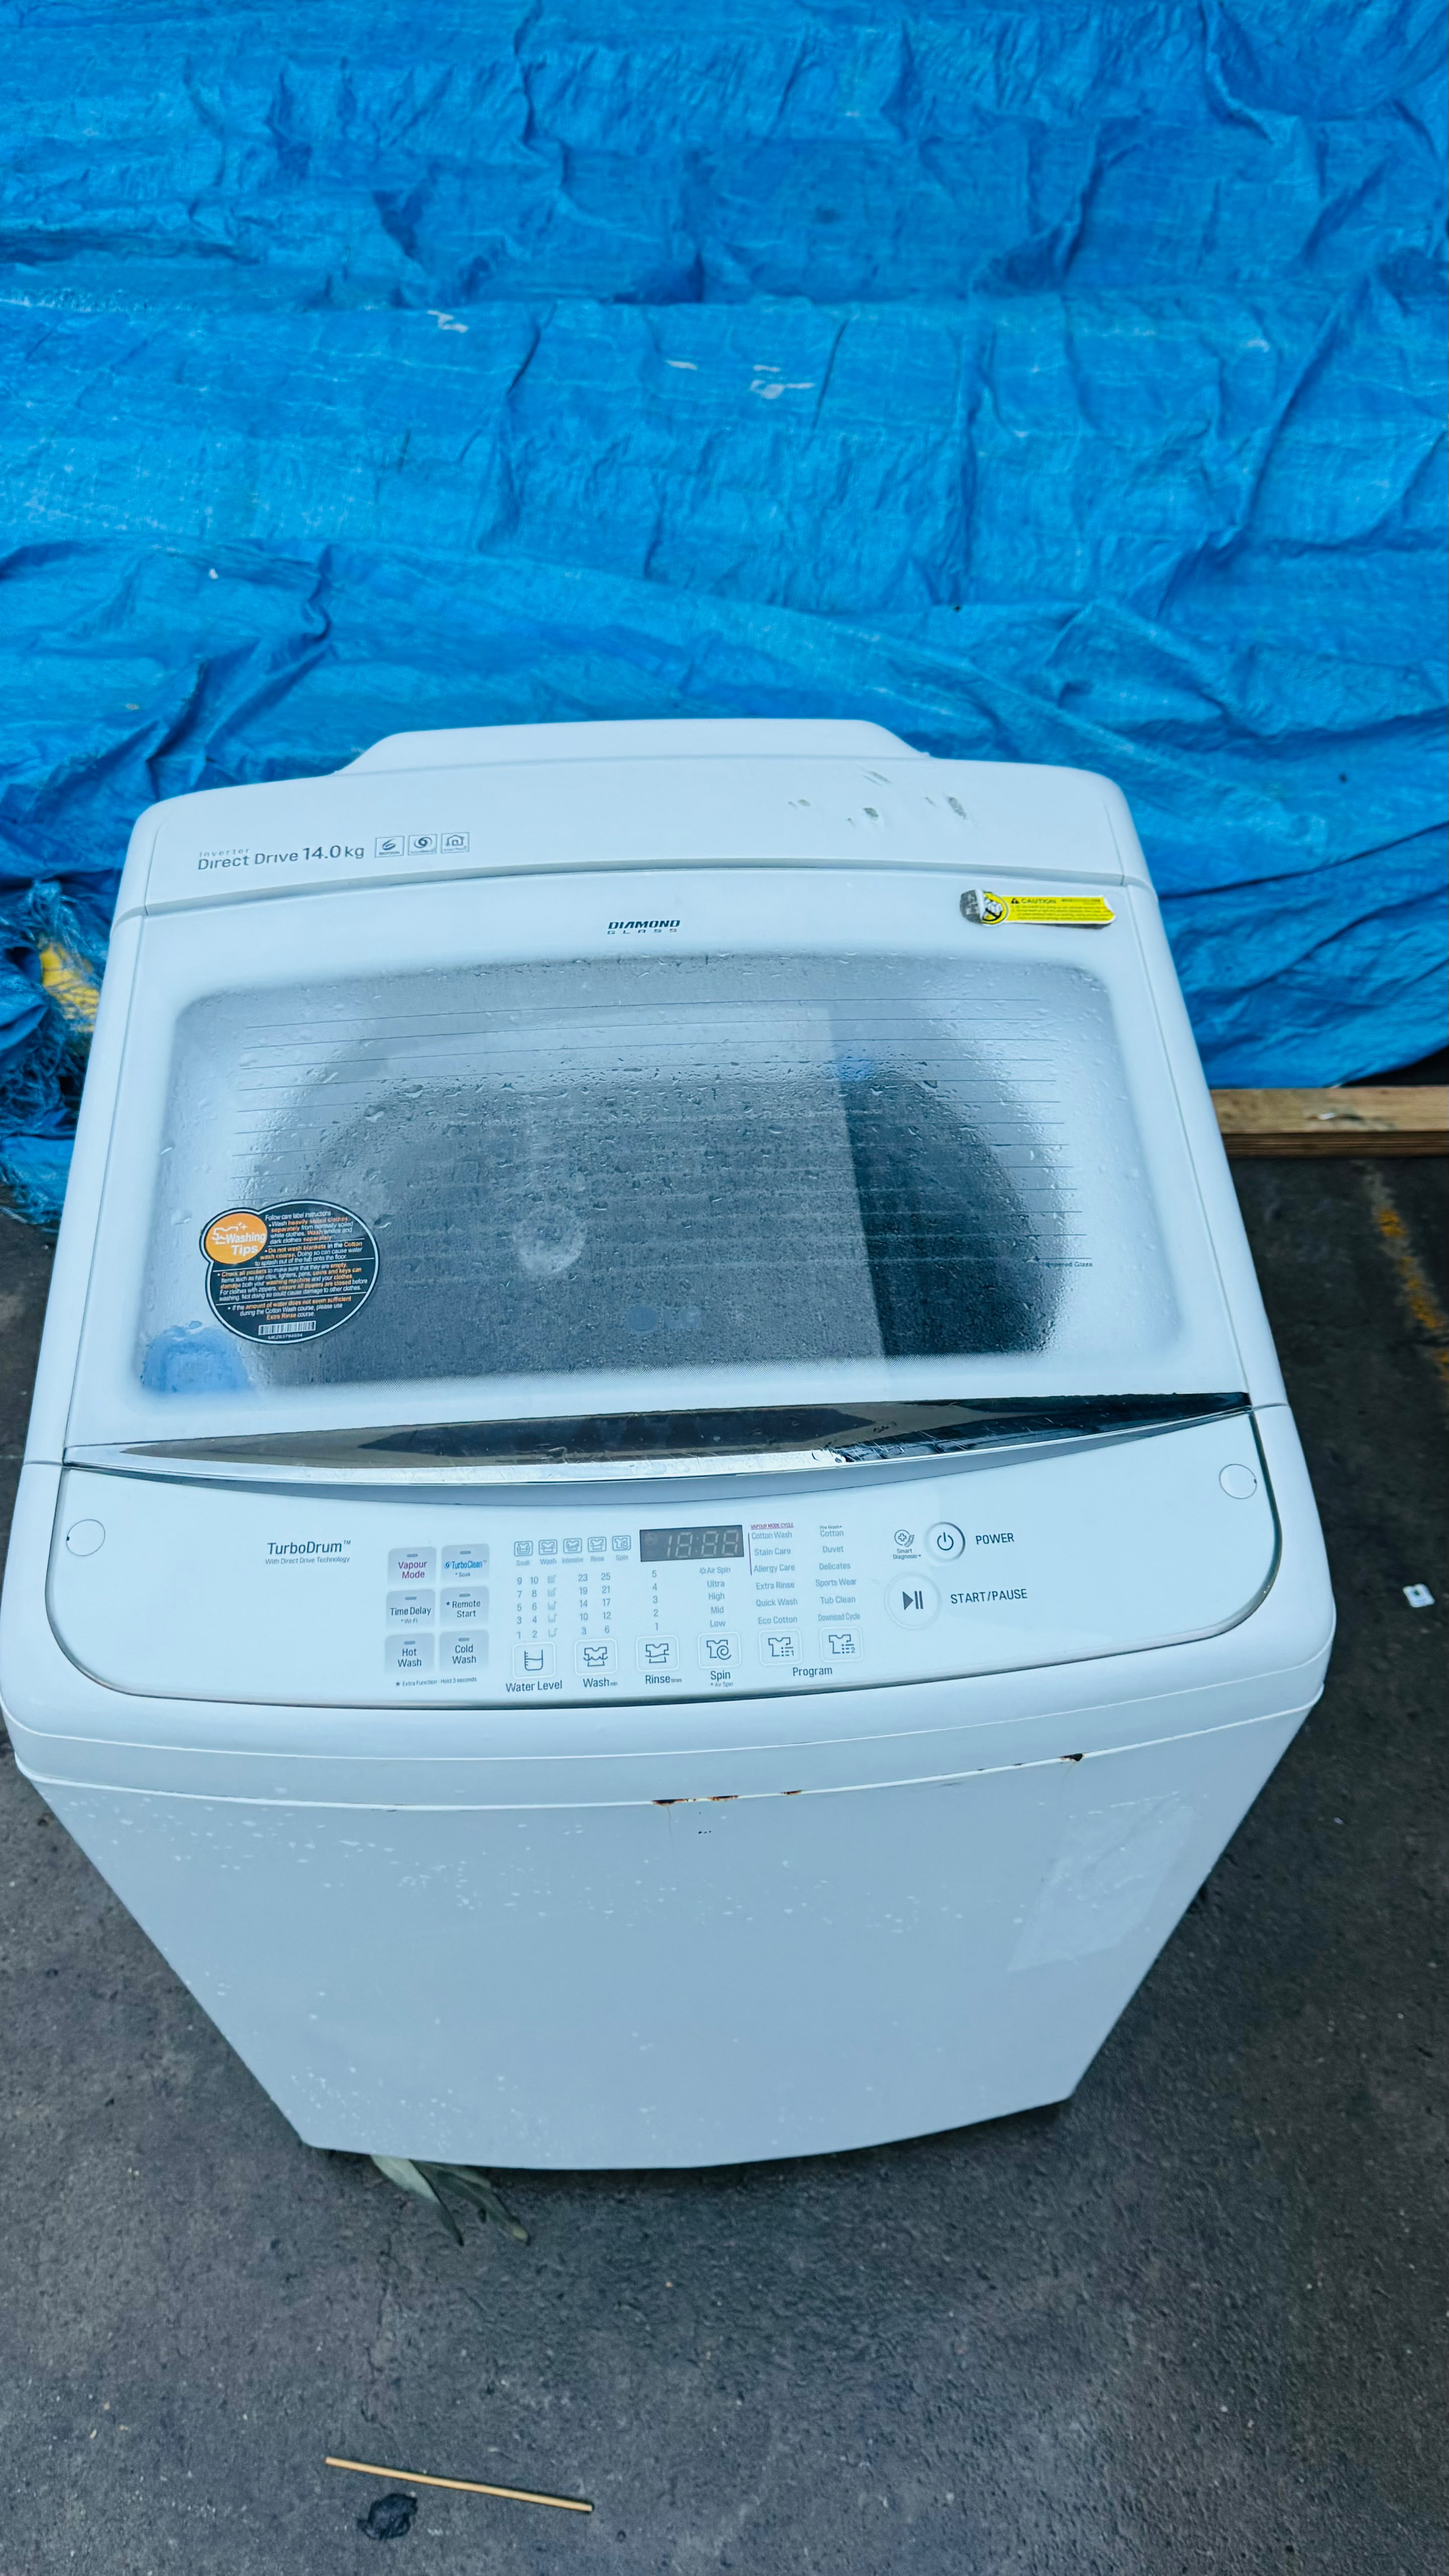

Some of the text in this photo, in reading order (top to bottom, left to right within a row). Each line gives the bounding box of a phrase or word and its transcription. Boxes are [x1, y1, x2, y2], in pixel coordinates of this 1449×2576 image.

[198, 855, 250, 870] Direct
[255, 852, 298, 865] Drive
[608, 920, 680, 929] DIAMOND
[225, 1232, 266, 1244] Washing
[231, 1244, 259, 1257] Tips
[752, 1531, 792, 1540] Cotton Wash
[976, 1533, 1014, 1545] POWER
[398, 1561, 427, 1570] Vapour
[754, 1564, 778, 1573] Allergy
[819, 1562, 851, 1570] Delicates
[402, 1570, 425, 1579] Mode
[652, 1570, 657, 1578] 5
[717, 1566, 731, 1575] Spin
[530, 1576, 539, 1584] 10
[578, 1572, 611, 1582] 23 25
[756, 1582, 774, 1590] Extra
[816, 1579, 837, 1588] Sports
[579, 1585, 610, 1595] 19 21
[653, 1595, 658, 1604] 3
[708, 1592, 725, 1601] High
[820, 1596, 834, 1604] Tub
[950, 1589, 1028, 1604] START/PAUSE
[452, 1600, 480, 1608] Remote
[603, 1598, 611, 1606] 17
[756, 1598, 798, 1607] Quick Wash
[390, 1606, 432, 1616] Time Delay
[517, 1603, 522, 1612] 5
[710, 1606, 725, 1614] Mid
[457, 1610, 476, 1618] Start
[580, 1612, 611, 1621] 10 12
[654, 1609, 659, 1617] 2
[818, 1613, 860, 1622] Download Cycle
[517, 1616, 537, 1625] 3 4
[758, 1616, 797, 1625] Eco Cotton
[605, 1626, 610, 1634] 6
[655, 1623, 659, 1631] 1
[516, 1630, 537, 1639] 1 2
[402, 1648, 417, 1656] Hot
[455, 1644, 473, 1653] Cold
[397, 1659, 422, 1667] Wash
[452, 1655, 476, 1664] Wash
[710, 1670, 731, 1681] Spin
[793, 1667, 833, 1678] Program
[583, 1677, 609, 1688] Wash
[645, 1674, 670, 1684] Rinse
[506, 1680, 562, 1693] Water Level
